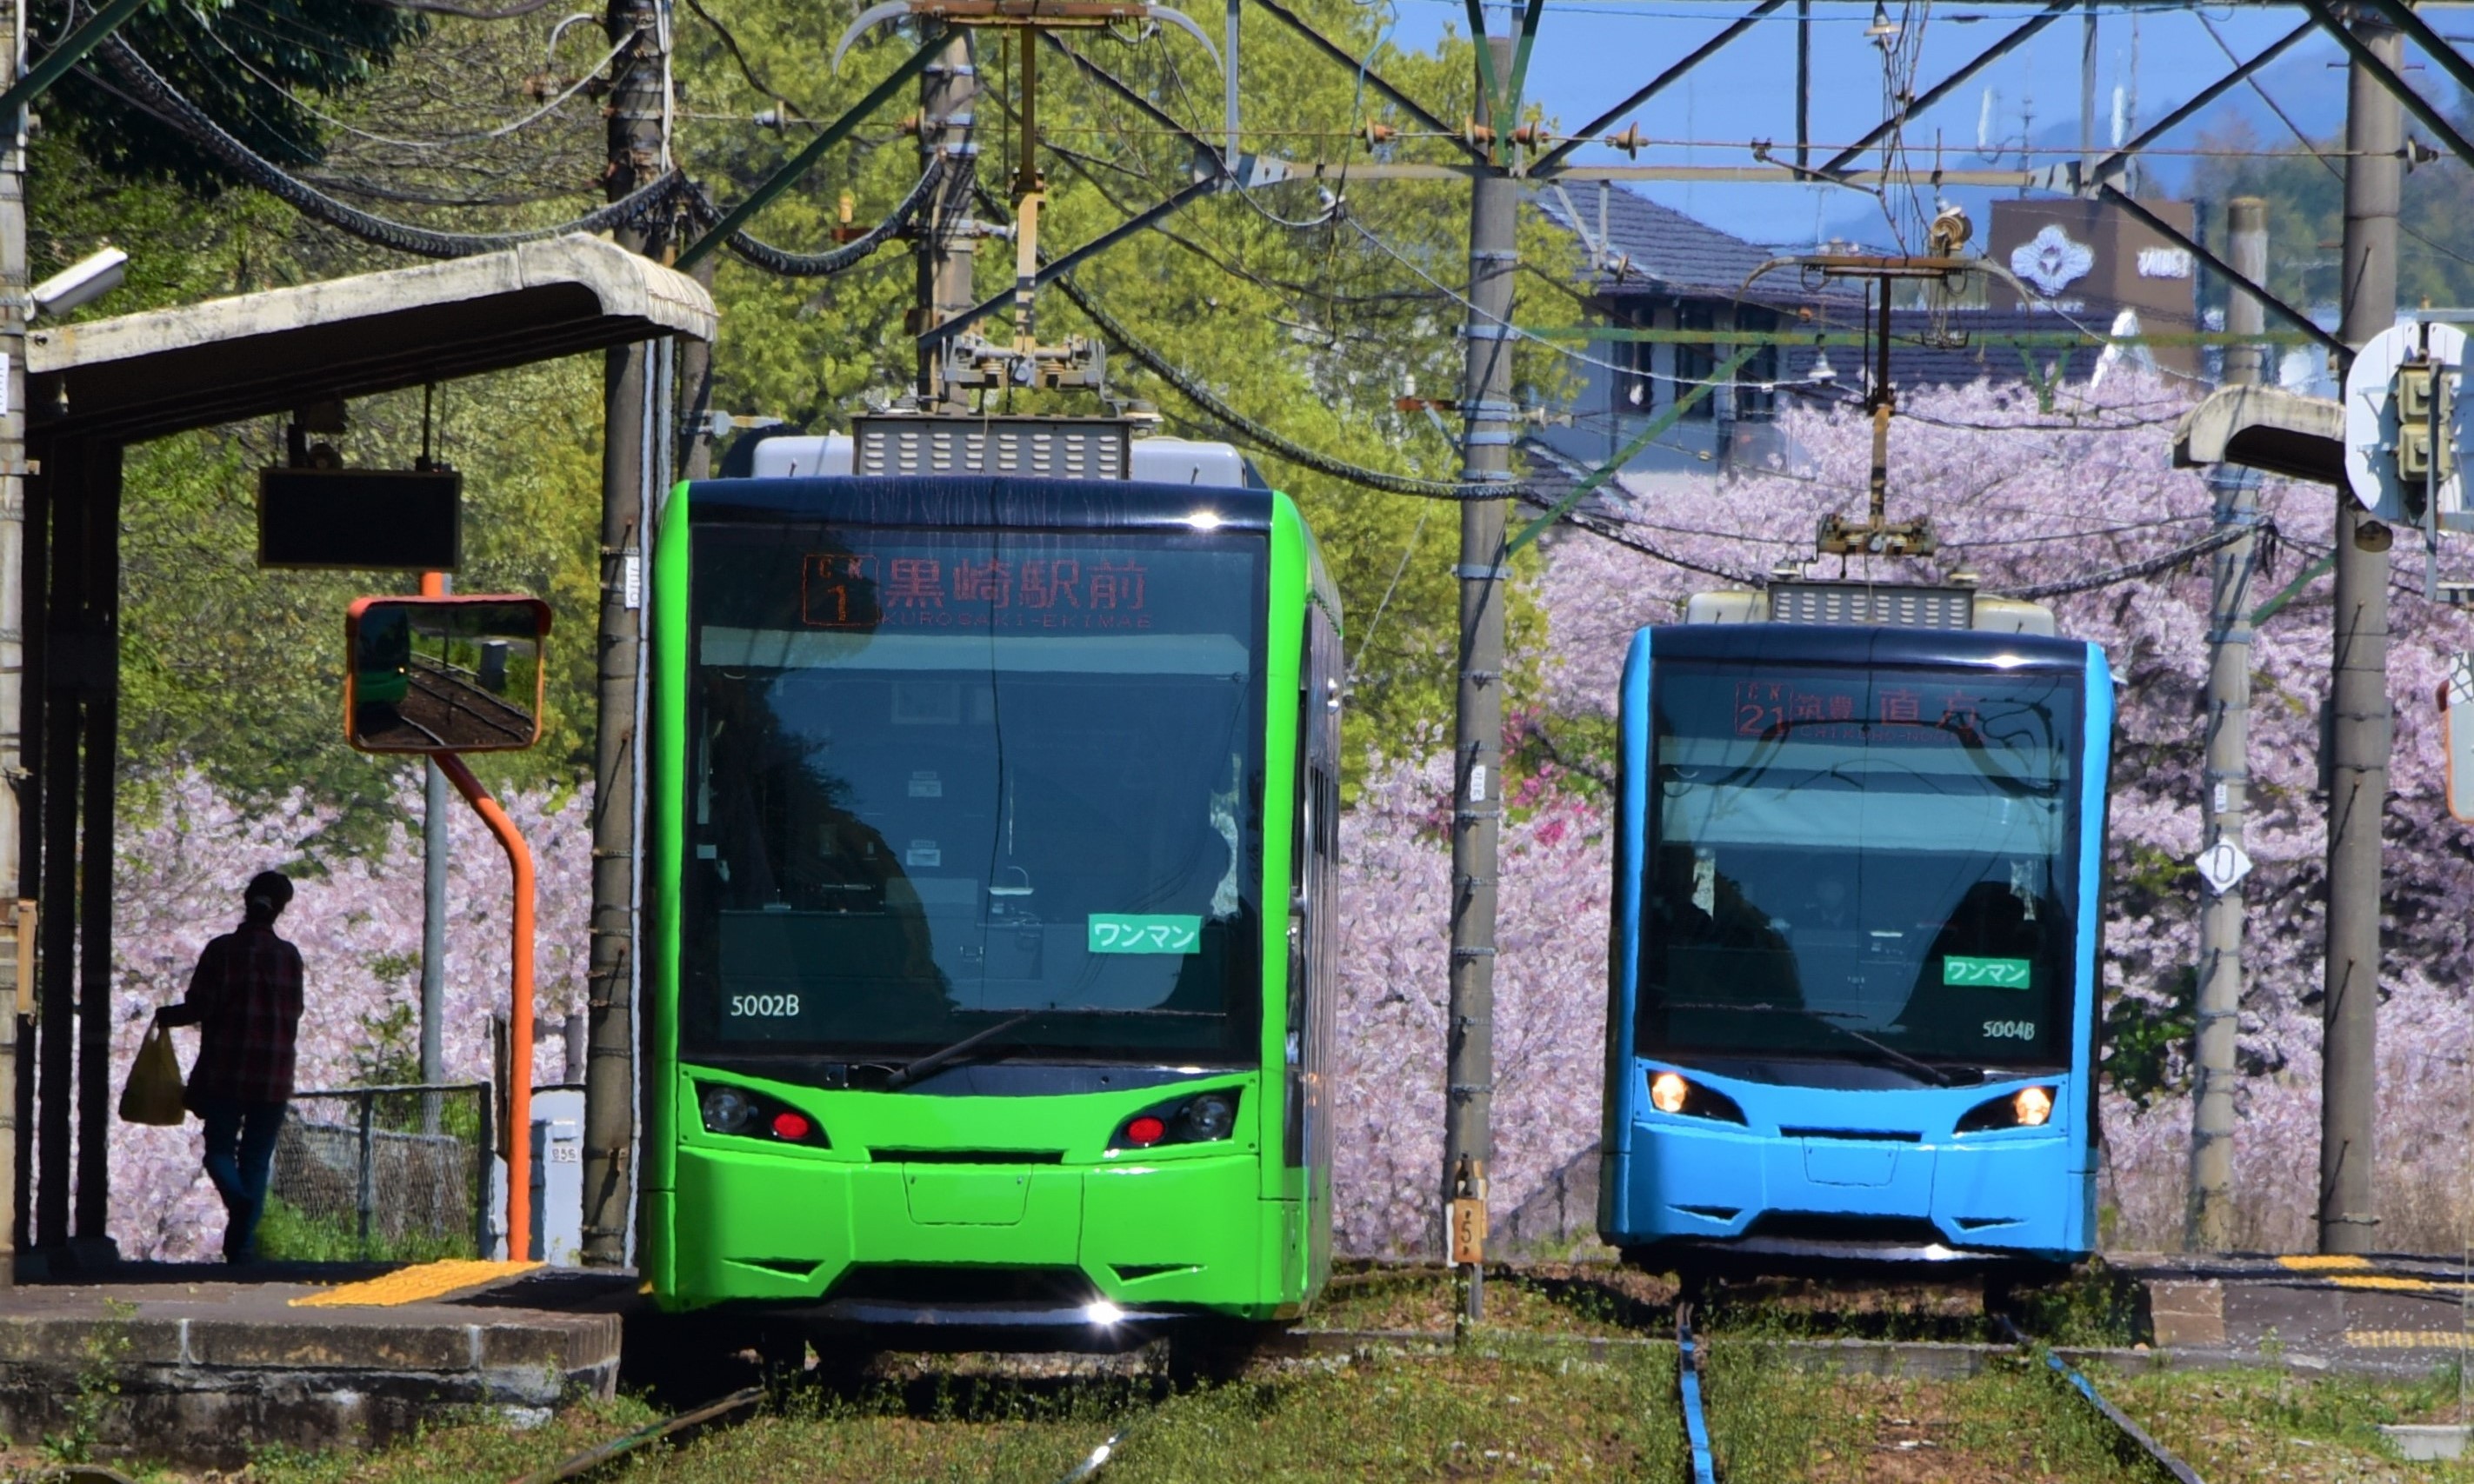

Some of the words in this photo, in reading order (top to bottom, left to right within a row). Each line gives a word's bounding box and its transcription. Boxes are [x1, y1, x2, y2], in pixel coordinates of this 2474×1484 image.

[884, 557, 1148, 609] 黒崎駅前
[828, 584, 847, 622] 1
[881, 610, 1152, 629] KUROSAKI-EKIMAE
[1739, 703, 1785, 735] 21
[1094, 923, 1195, 948] ワンマン
[1948, 962, 2026, 982] ワンマン
[730, 994, 799, 1016] 5002B
[1983, 1021, 2035, 1041] 5004B
